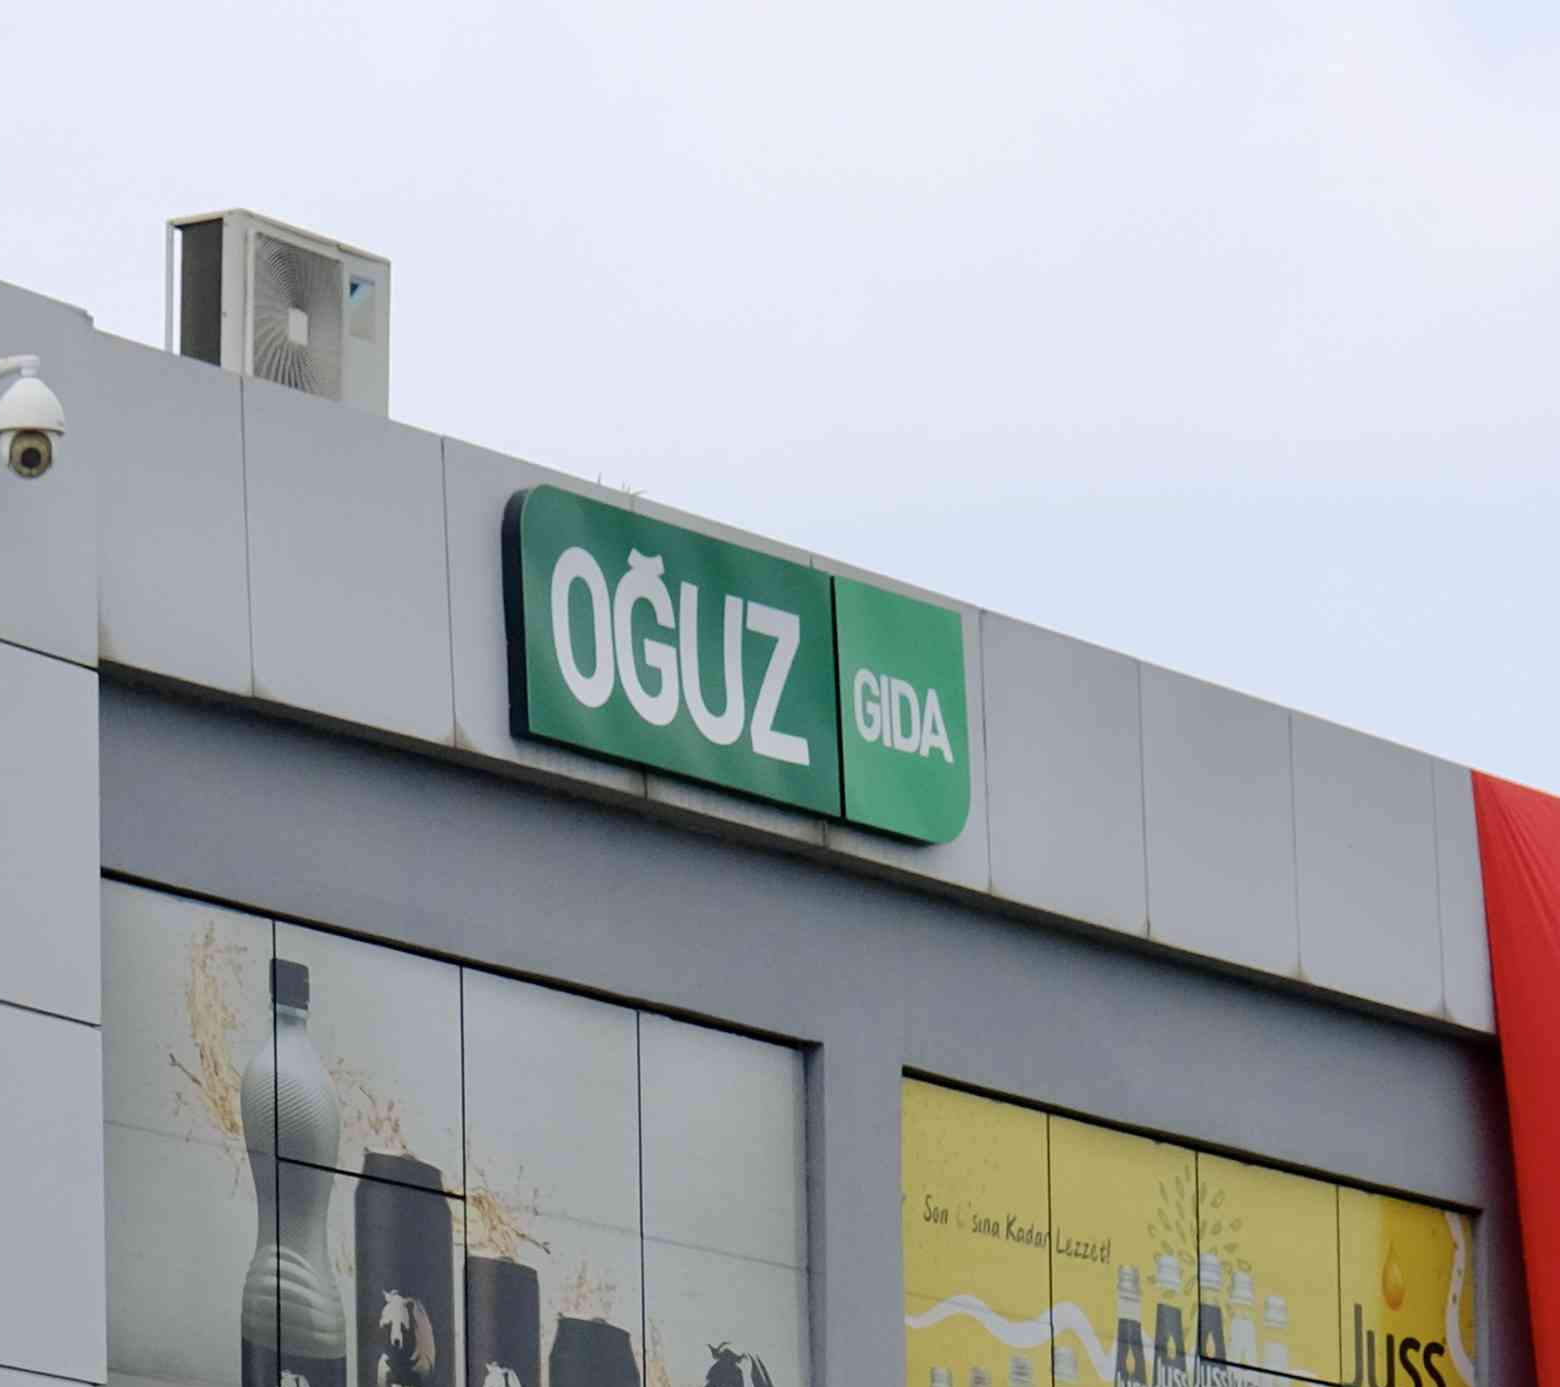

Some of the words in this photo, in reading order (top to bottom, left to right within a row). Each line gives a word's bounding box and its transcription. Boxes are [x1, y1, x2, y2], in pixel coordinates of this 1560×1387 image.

[551, 546, 810, 766] OĞUZ
[853, 668, 955, 764] GIDA
[923, 1194, 948, 1224] Son
[1006, 1213, 1050, 1248] Kadar
[1055, 1229, 1111, 1264] Lezzet!
